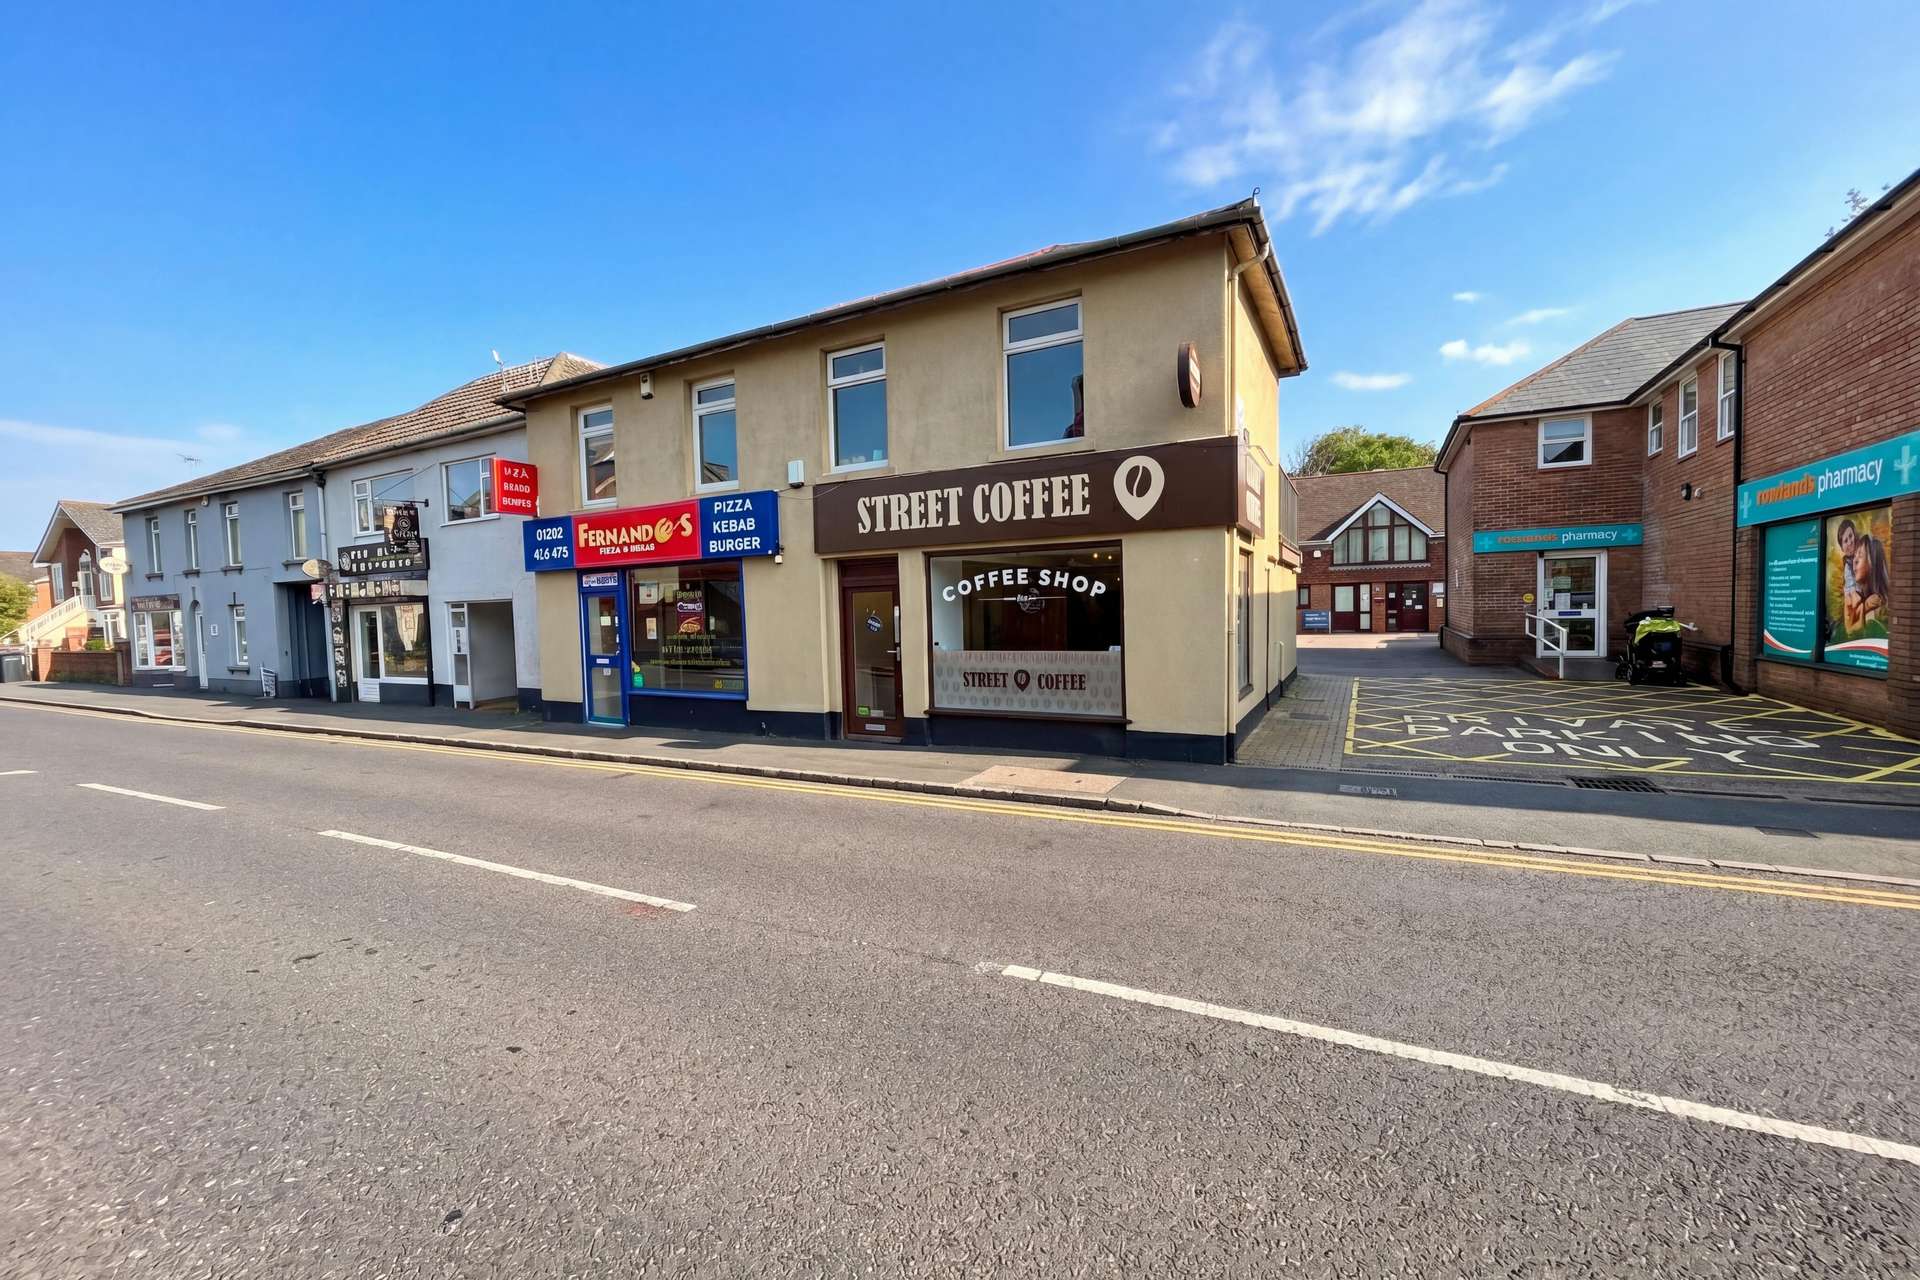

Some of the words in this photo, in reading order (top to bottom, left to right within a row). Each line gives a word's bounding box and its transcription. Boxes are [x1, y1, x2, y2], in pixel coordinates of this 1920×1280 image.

[1817, 458, 1884, 499] pharmacy
[714, 498, 753, 514] PIZZA
[857, 487, 963, 534] STREET
[973, 474, 1091, 524] COFFEE
[536, 527, 564, 541] 01202
[713, 518, 756, 533] KEBAB
[709, 537, 761, 553] BURGER
[1562, 530, 1618, 544] pharmacy
[552, 546, 569, 559] 475
[942, 568, 1029, 602] COFFEE
[1038, 569, 1107, 598] SHOP
[963, 671, 1009, 688] STREET
[1037, 673, 1087, 691] COFFEE
[1403, 714, 1782, 734] PRIVATE
[1502, 741, 1747, 763] ONLY
